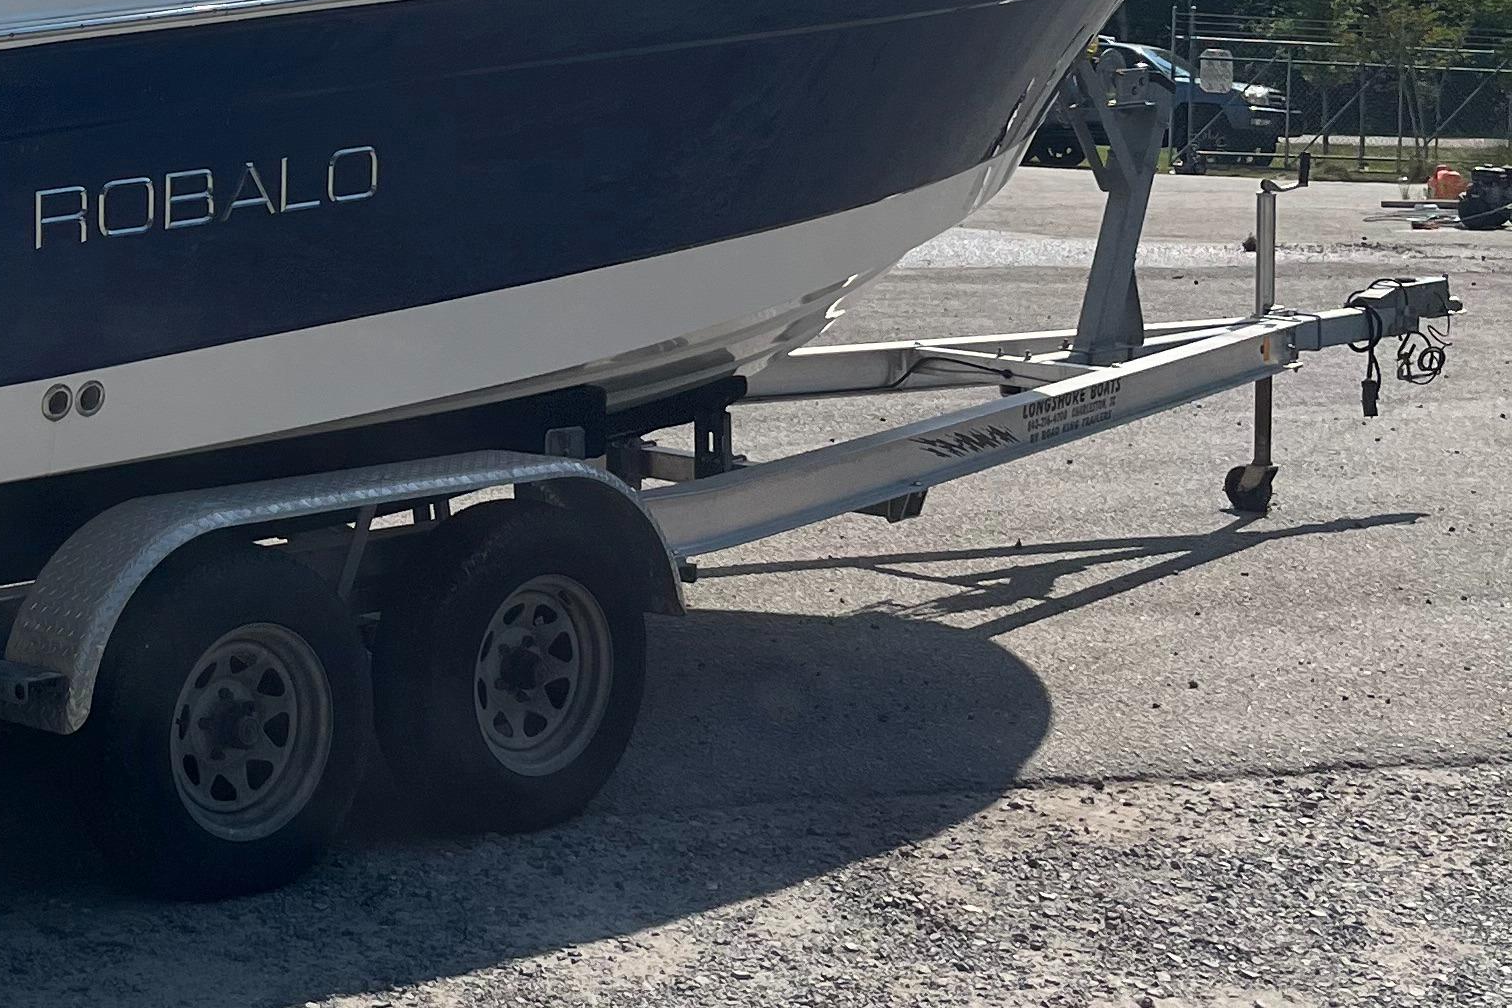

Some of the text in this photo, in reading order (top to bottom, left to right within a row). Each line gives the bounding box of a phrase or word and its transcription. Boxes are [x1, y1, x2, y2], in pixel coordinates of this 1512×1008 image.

[34, 145, 378, 250] ROBALO
[1022, 378, 1121, 419] LONGSHORE BOATS
